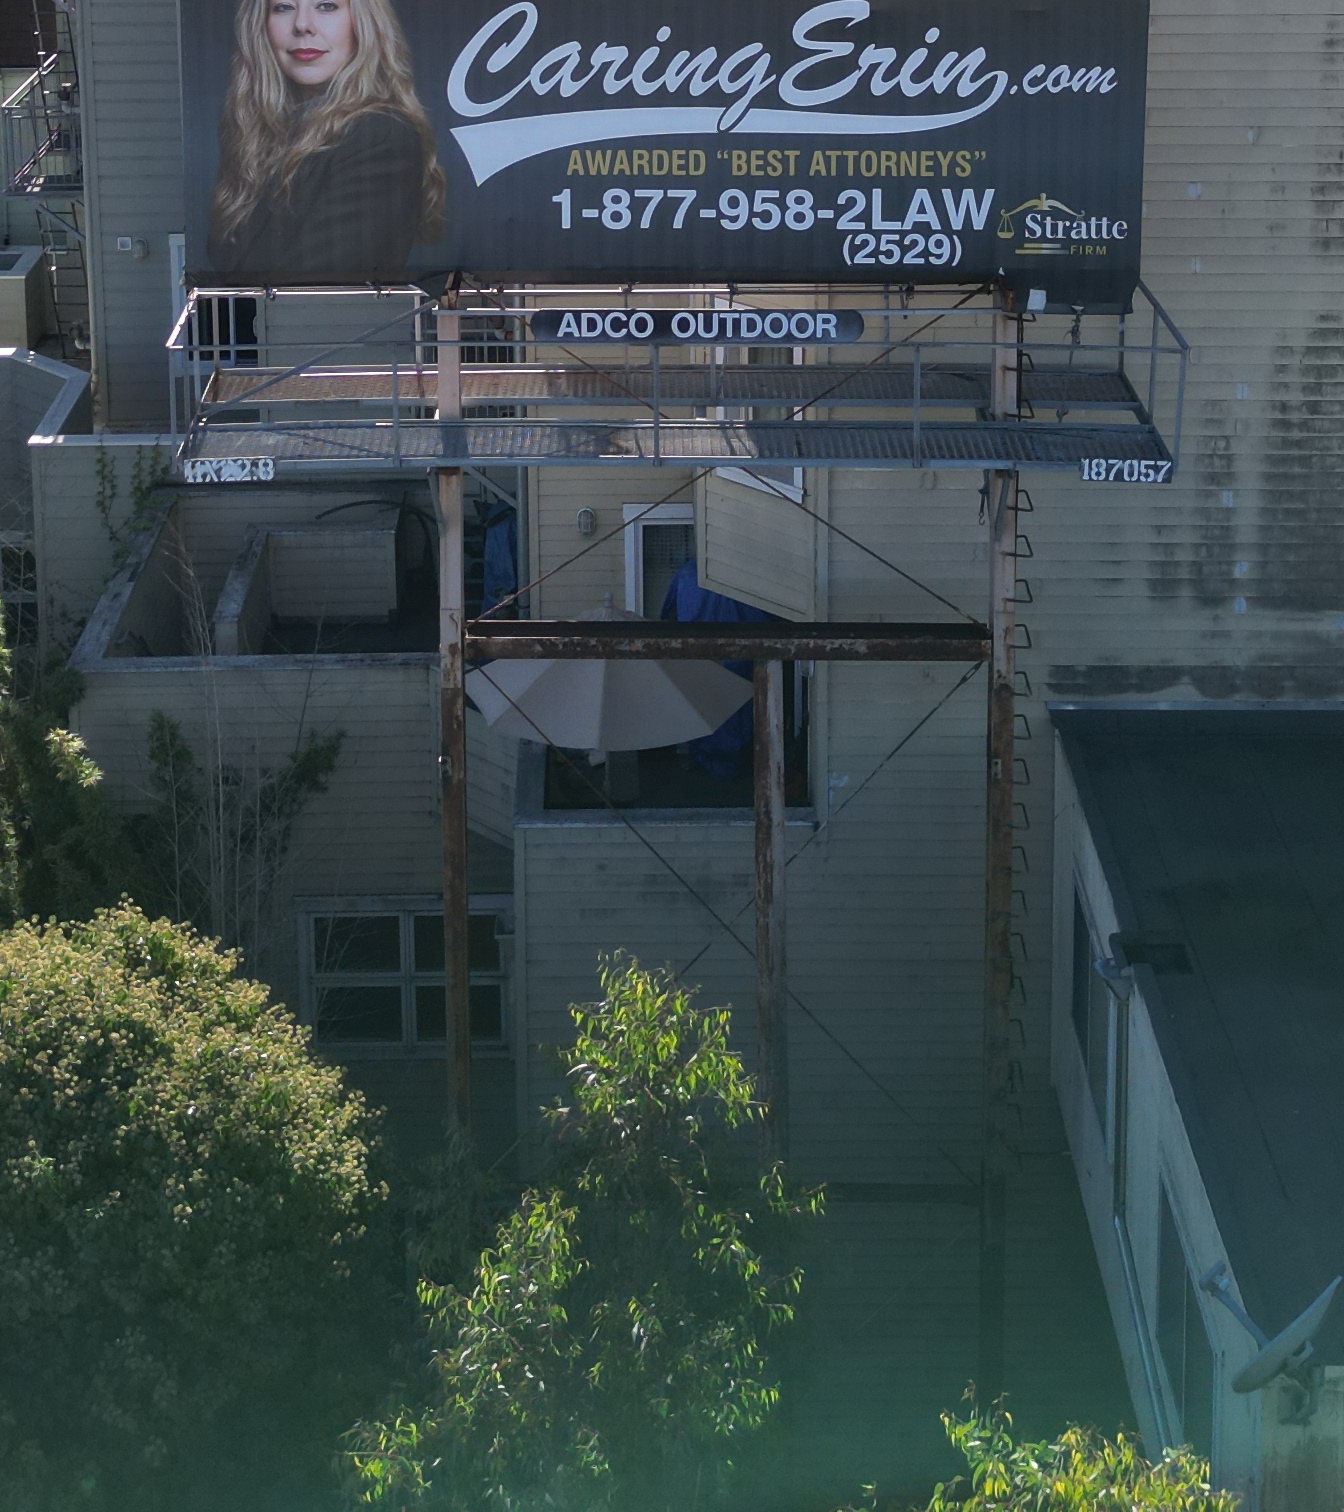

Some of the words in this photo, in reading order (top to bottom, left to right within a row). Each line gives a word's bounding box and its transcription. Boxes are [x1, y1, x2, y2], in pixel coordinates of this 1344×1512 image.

[446, 0, 1118, 134] CaringErin.com
[566, 149, 706, 177] AWARDED
[717, 150, 801, 177] “BEST
[809, 150, 987, 179] ATTORNEYS”
[551, 187, 995, 231] 1-877-958-2LAW
[1024, 212, 1128, 239] Stratte
[842, 233, 963, 267] (2529)
[1070, 245, 1107, 256] FIRM
[557, 311, 655, 340] ADCO
[670, 312, 839, 340] OUTDOOR
[1080, 458, 1172, 483] 187057
